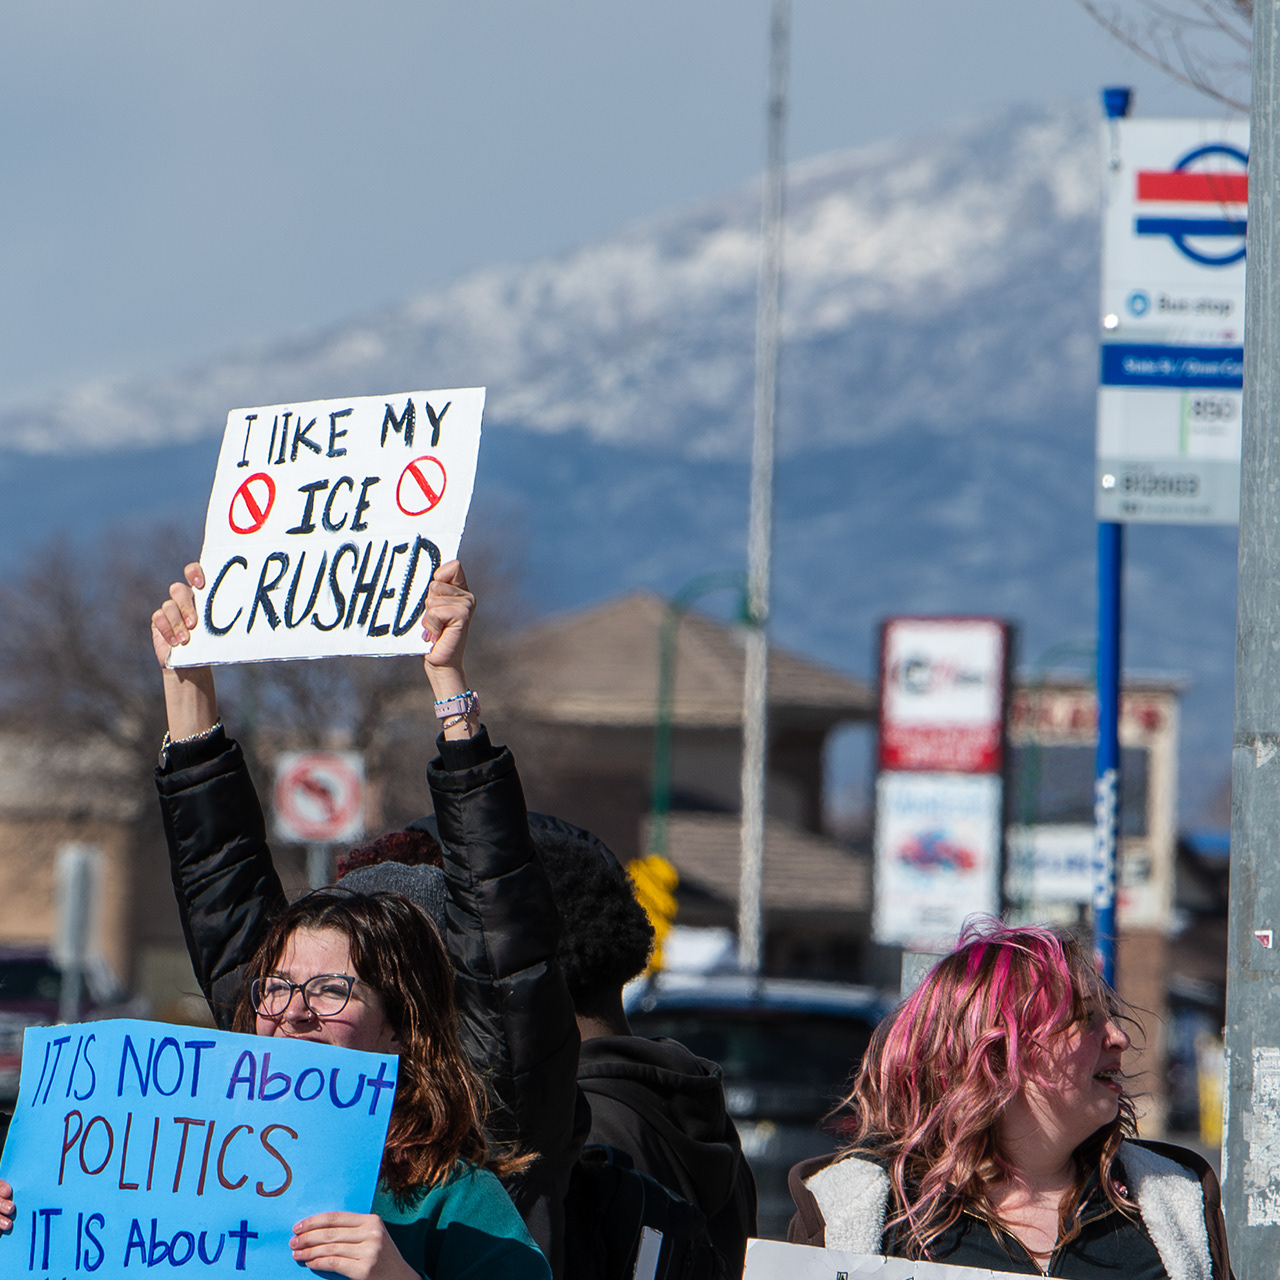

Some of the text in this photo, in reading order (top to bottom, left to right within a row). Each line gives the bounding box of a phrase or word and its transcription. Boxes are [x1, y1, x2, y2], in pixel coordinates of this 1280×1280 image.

[236, 414, 259, 468] I
[380, 397, 452, 449] MY
[285, 475, 381, 535] ICE
[204, 533, 442, 638] CRUSHED
[31, 1034, 72, 1108] IT
[65, 1033, 97, 1102] IS
[117, 1034, 217, 1099] NOT
[58, 1109, 300, 1198] POLITICS
[28, 1207, 63, 1272] IT
[75, 1211, 107, 1272] IS
